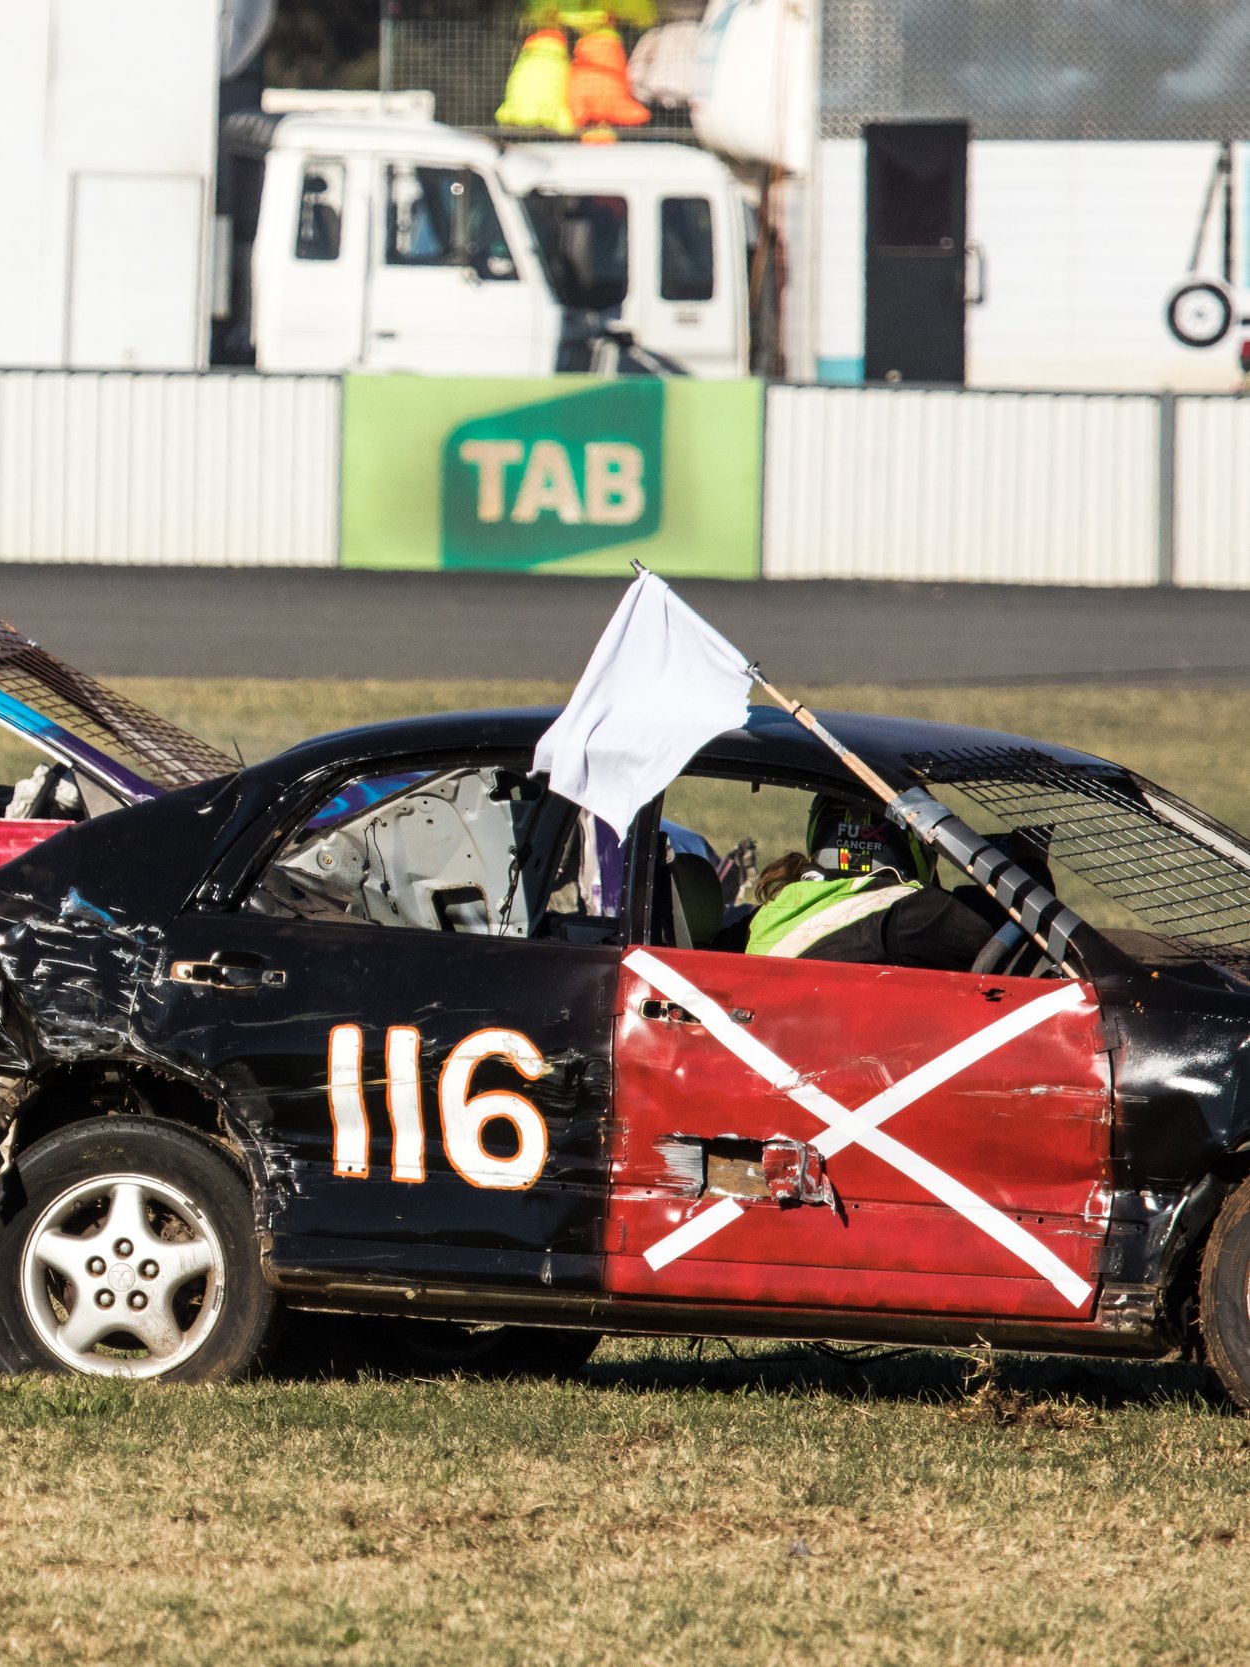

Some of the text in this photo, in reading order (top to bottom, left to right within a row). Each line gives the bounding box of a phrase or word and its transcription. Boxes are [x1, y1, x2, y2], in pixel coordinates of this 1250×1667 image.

[459, 438, 647, 527] TAB
[835, 838, 882, 851] CANCER
[328, 1023, 549, 1191] 116
